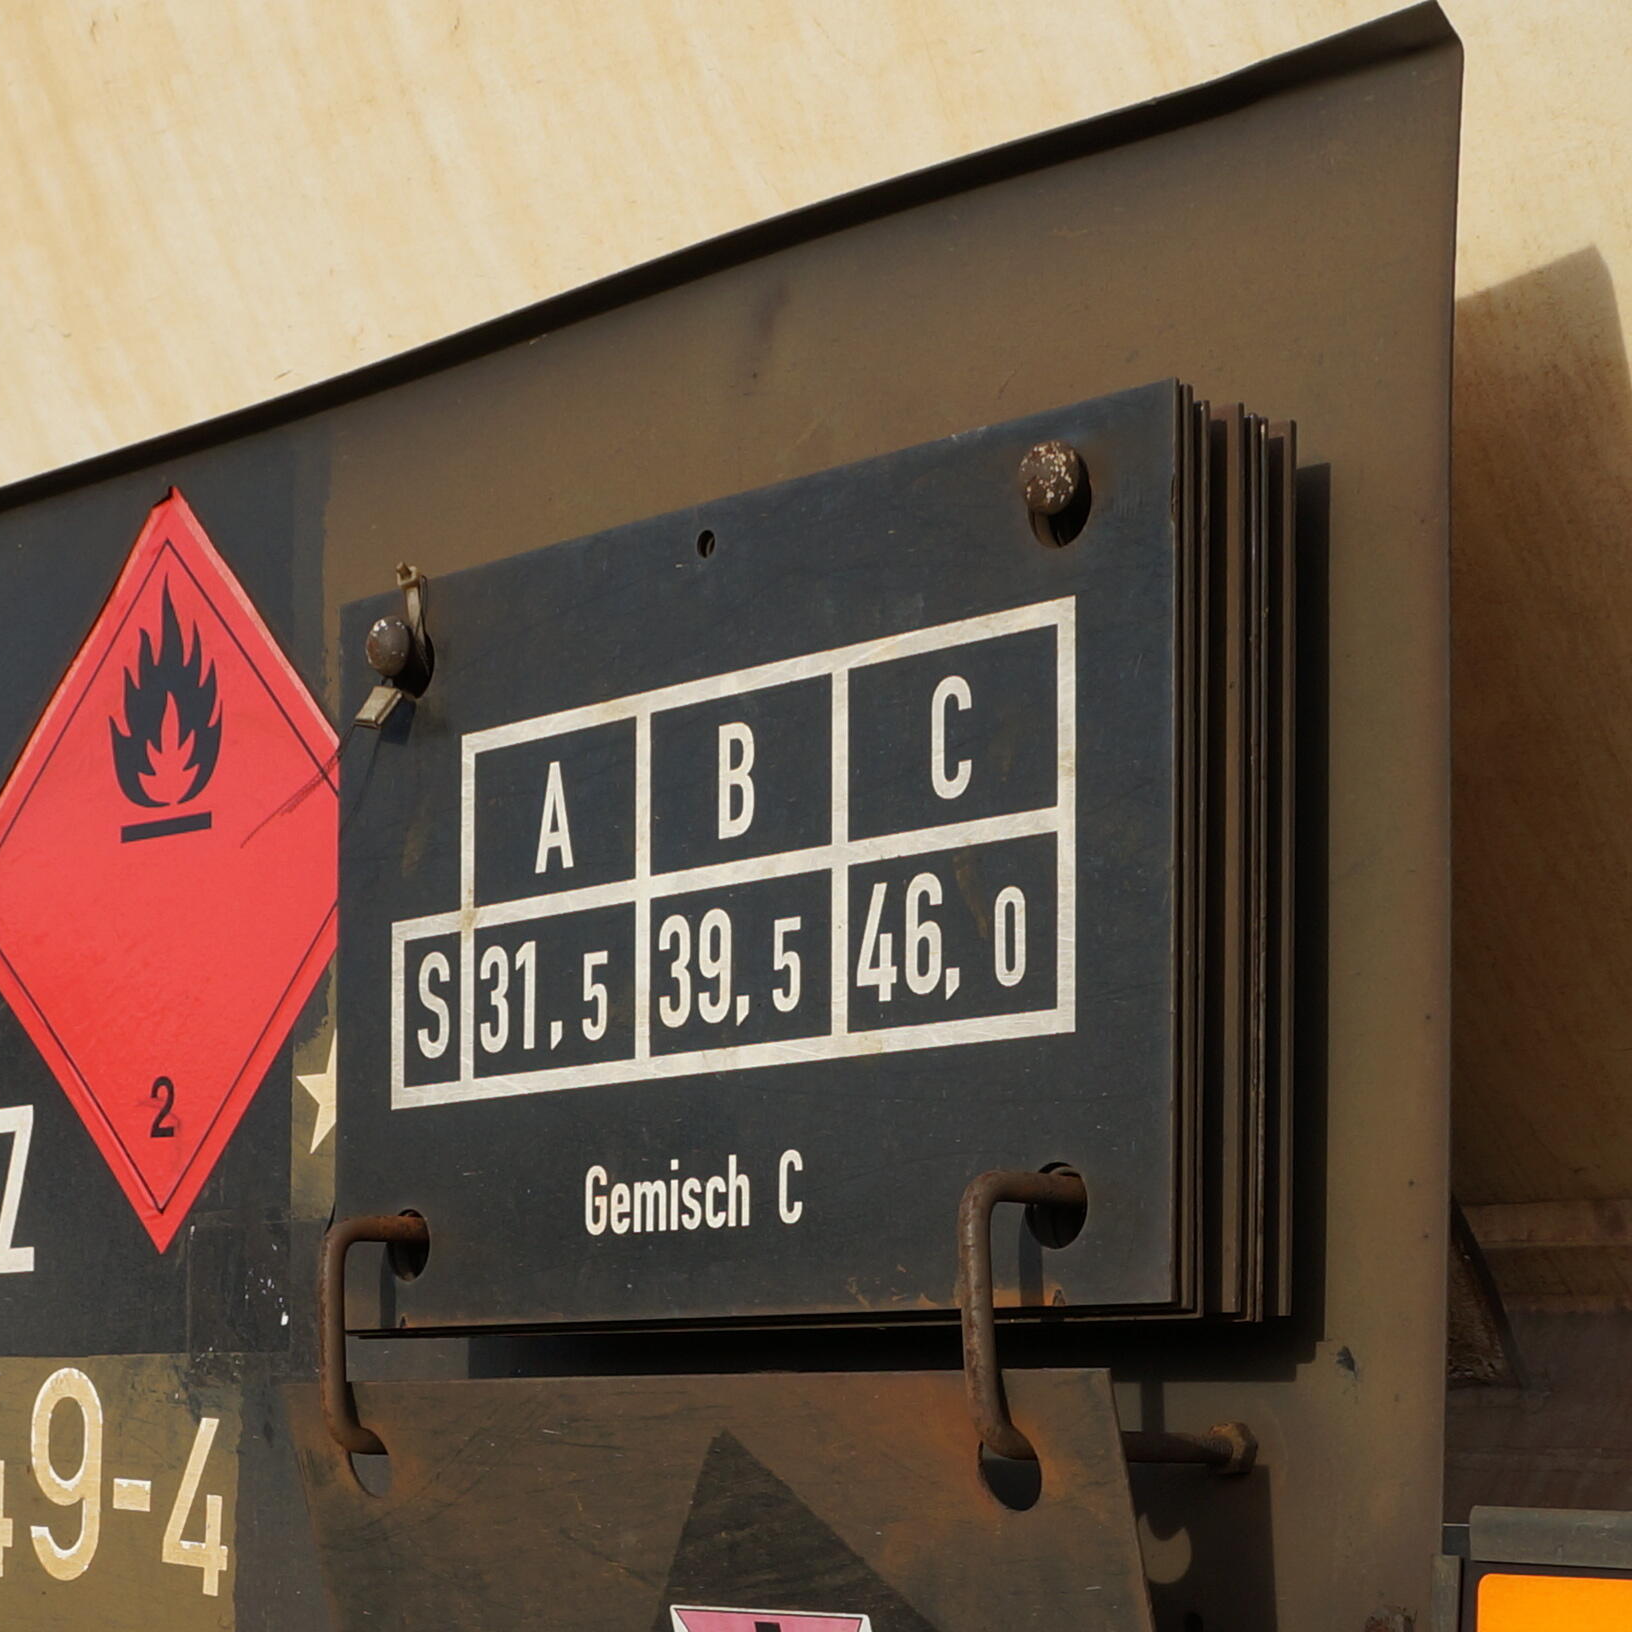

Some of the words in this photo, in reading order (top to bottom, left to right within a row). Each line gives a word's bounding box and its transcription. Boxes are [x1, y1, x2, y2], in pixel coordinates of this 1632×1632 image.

[534, 761, 575, 874] A
[718, 721, 755, 840] B
[930, 674, 973, 801] C
[417, 951, 450, 1059] S
[149, 1075, 175, 1139] 2
[584, 1153, 751, 1236] Gemisch
[778, 1148, 804, 1225] C
